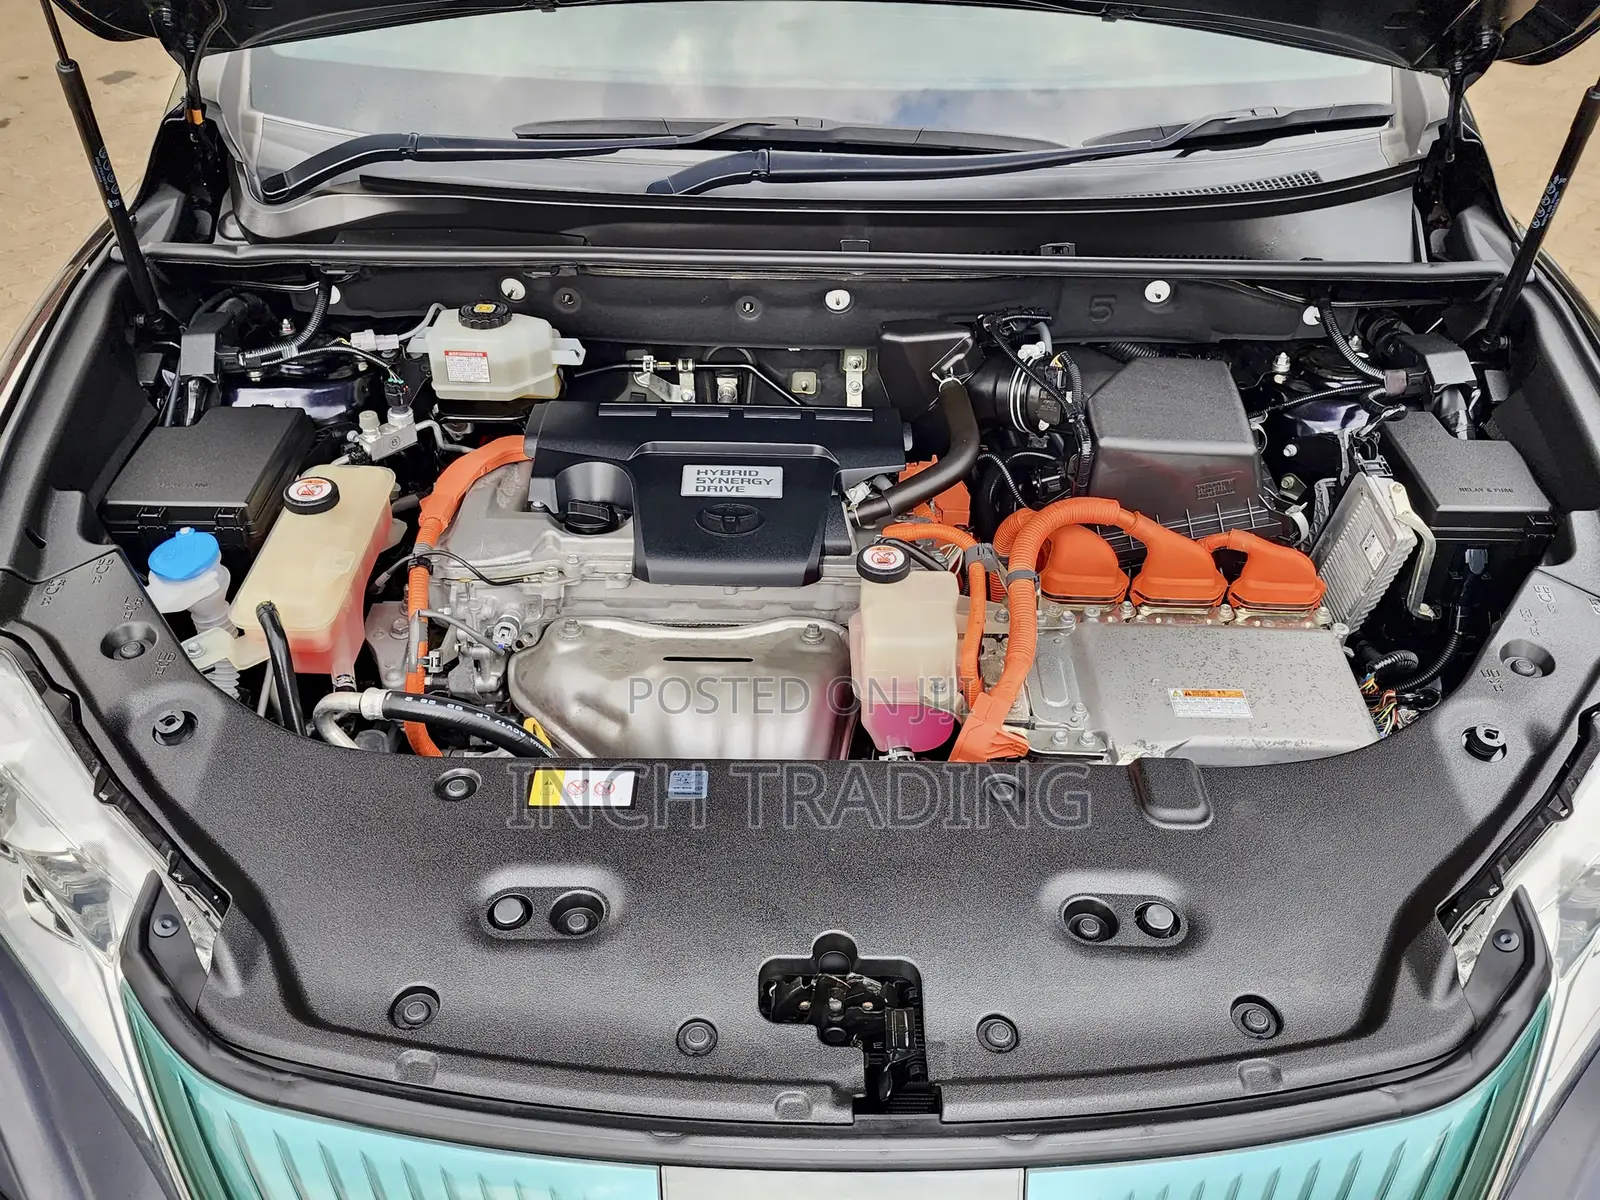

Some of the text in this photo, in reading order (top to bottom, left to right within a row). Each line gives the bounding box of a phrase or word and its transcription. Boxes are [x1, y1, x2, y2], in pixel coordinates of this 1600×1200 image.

[696, 469, 759, 477] HYBRID
[695, 477, 774, 486] SYNERGY
[695, 485, 746, 493] DRIVE
